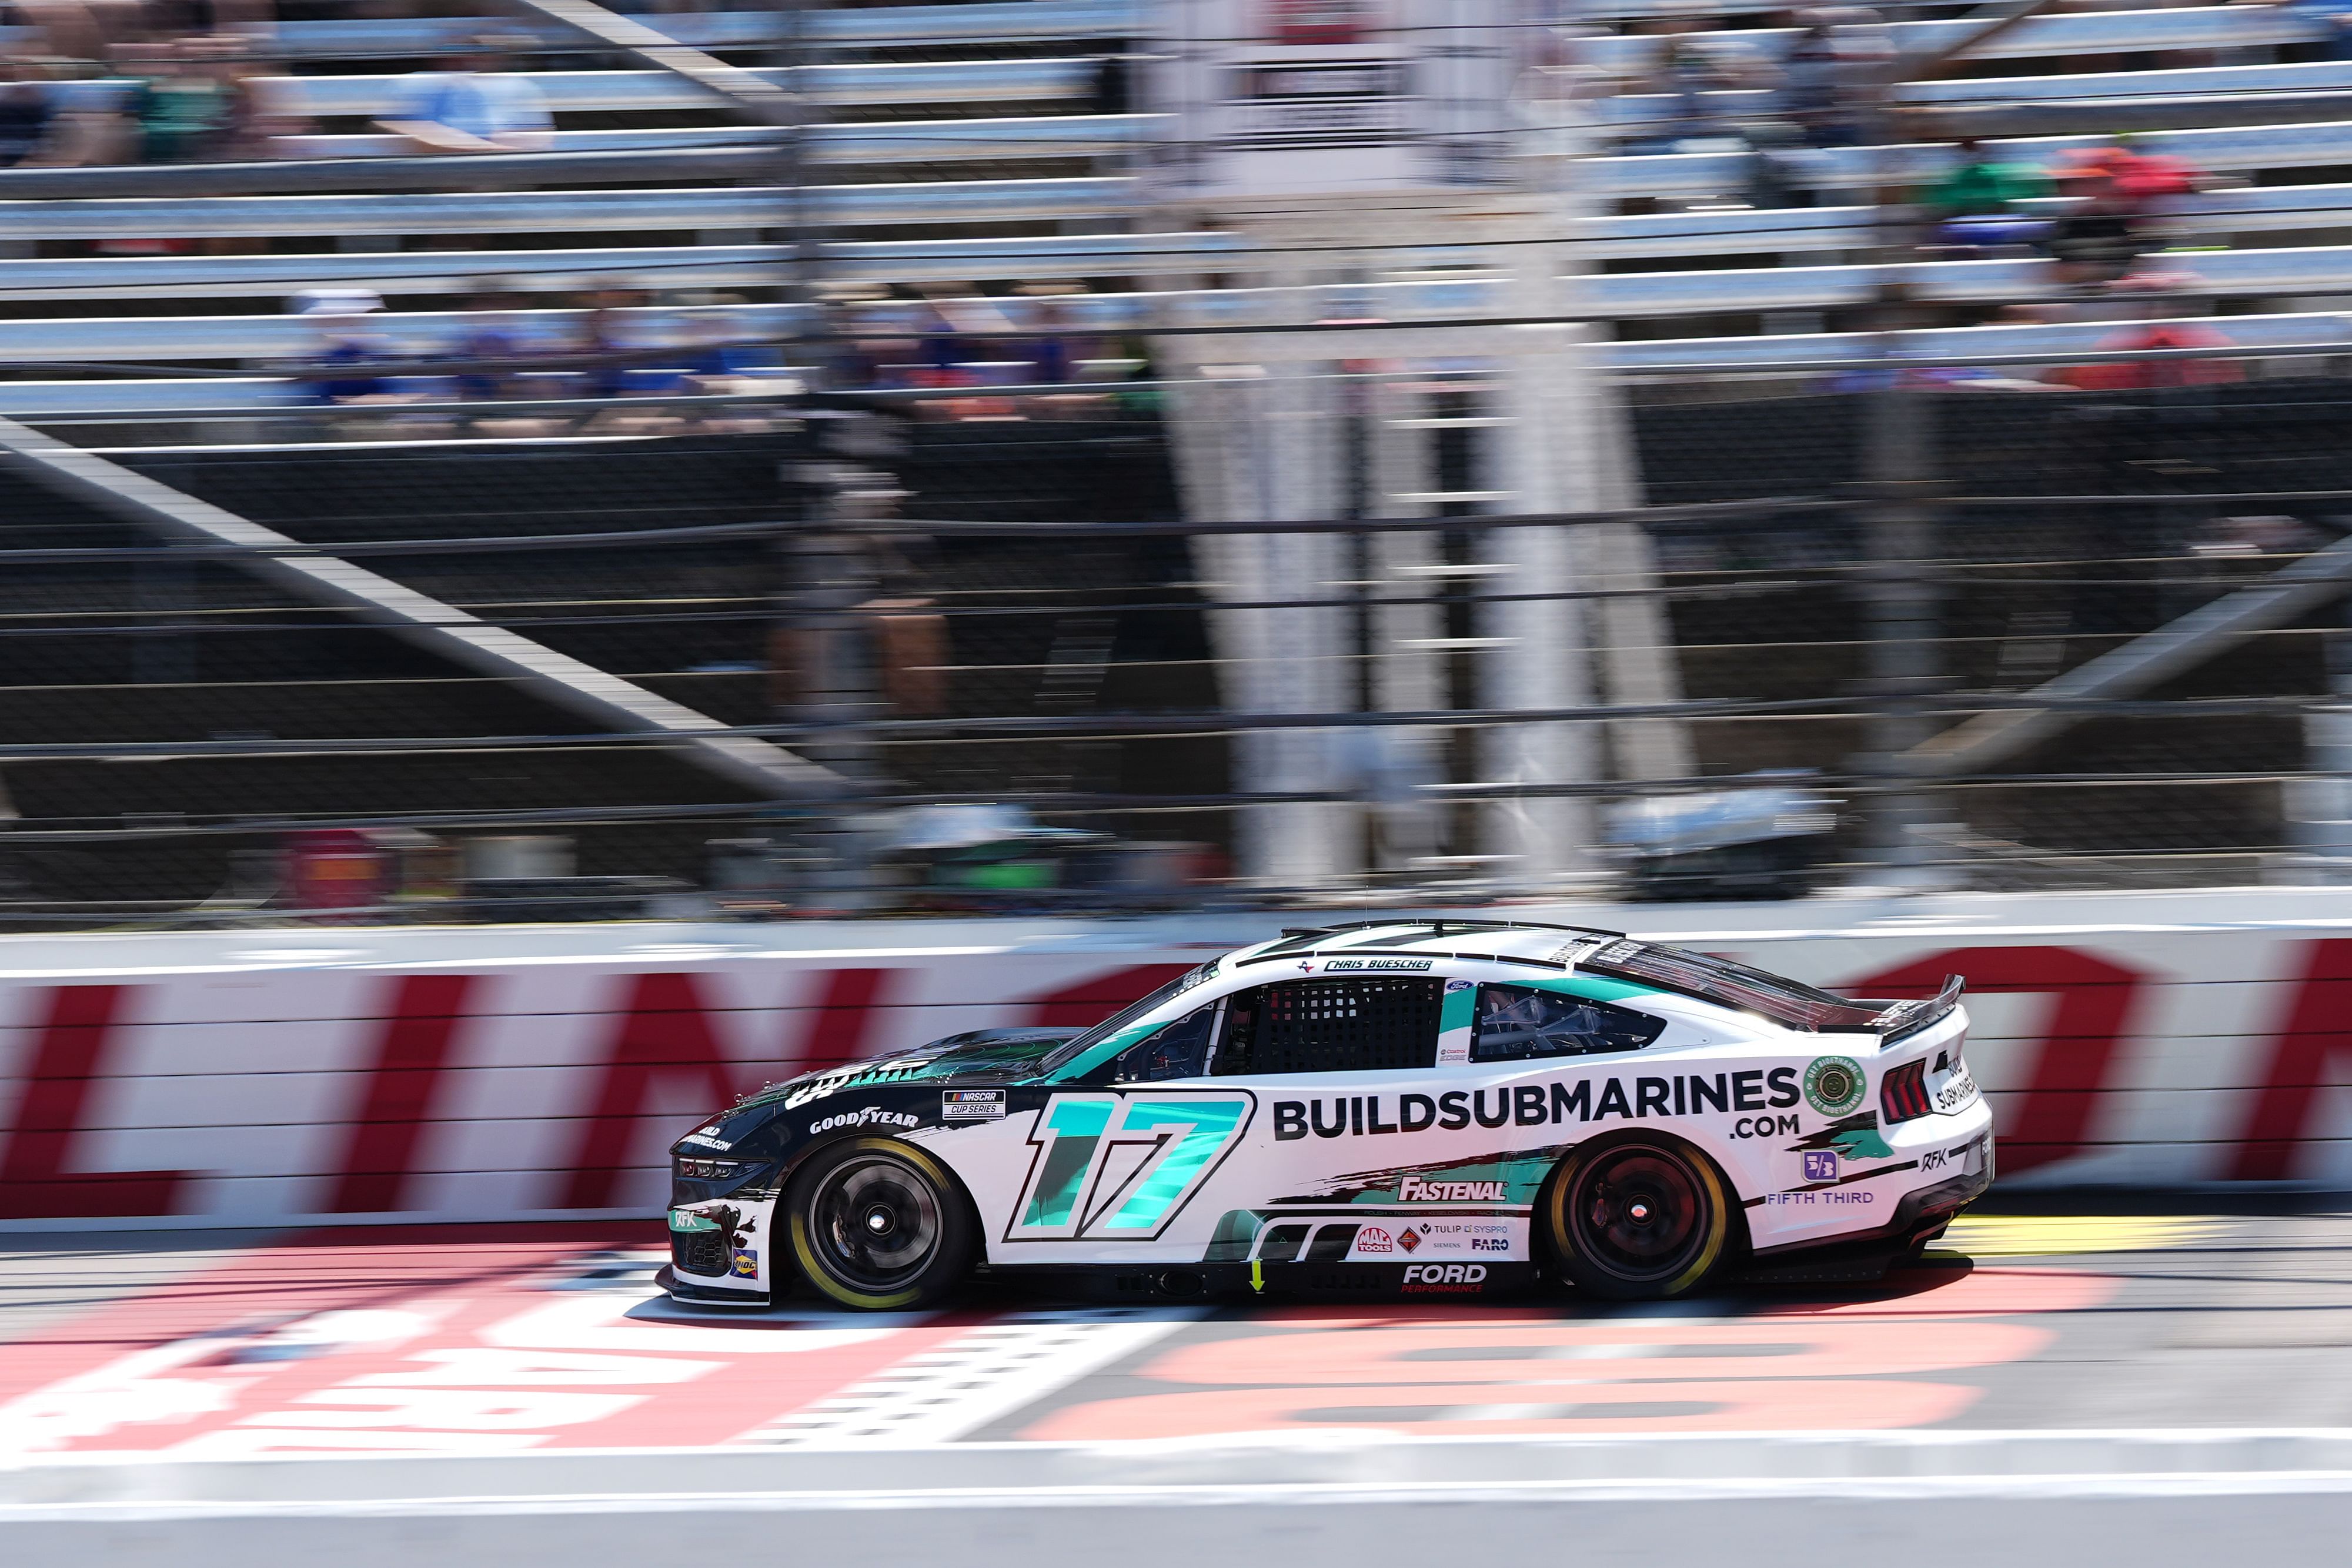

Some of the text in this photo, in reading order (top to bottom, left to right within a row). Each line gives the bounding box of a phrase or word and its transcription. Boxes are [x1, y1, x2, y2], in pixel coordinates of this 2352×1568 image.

[1325, 960, 1434, 970] CHRIS BUESCHER
[963, 1092, 997, 1101] NASCAR
[1273, 1067, 1800, 1141] BUILDSUBMARINES
[1729, 1114, 1800, 1139] .COM
[1007, 1092, 1253, 1239] 17
[1921, 1148, 1947, 1172] RFK
[1768, 1192, 1873, 1205] FIFTH THIRD
[675, 1211, 697, 1227] RFK
[1359, 1229, 1390, 1245] MAC
[1472, 1239, 1509, 1251] FARO
[1403, 1265, 1487, 1283] FORD
[1401, 1284, 1483, 1293] PERFORMANCE
